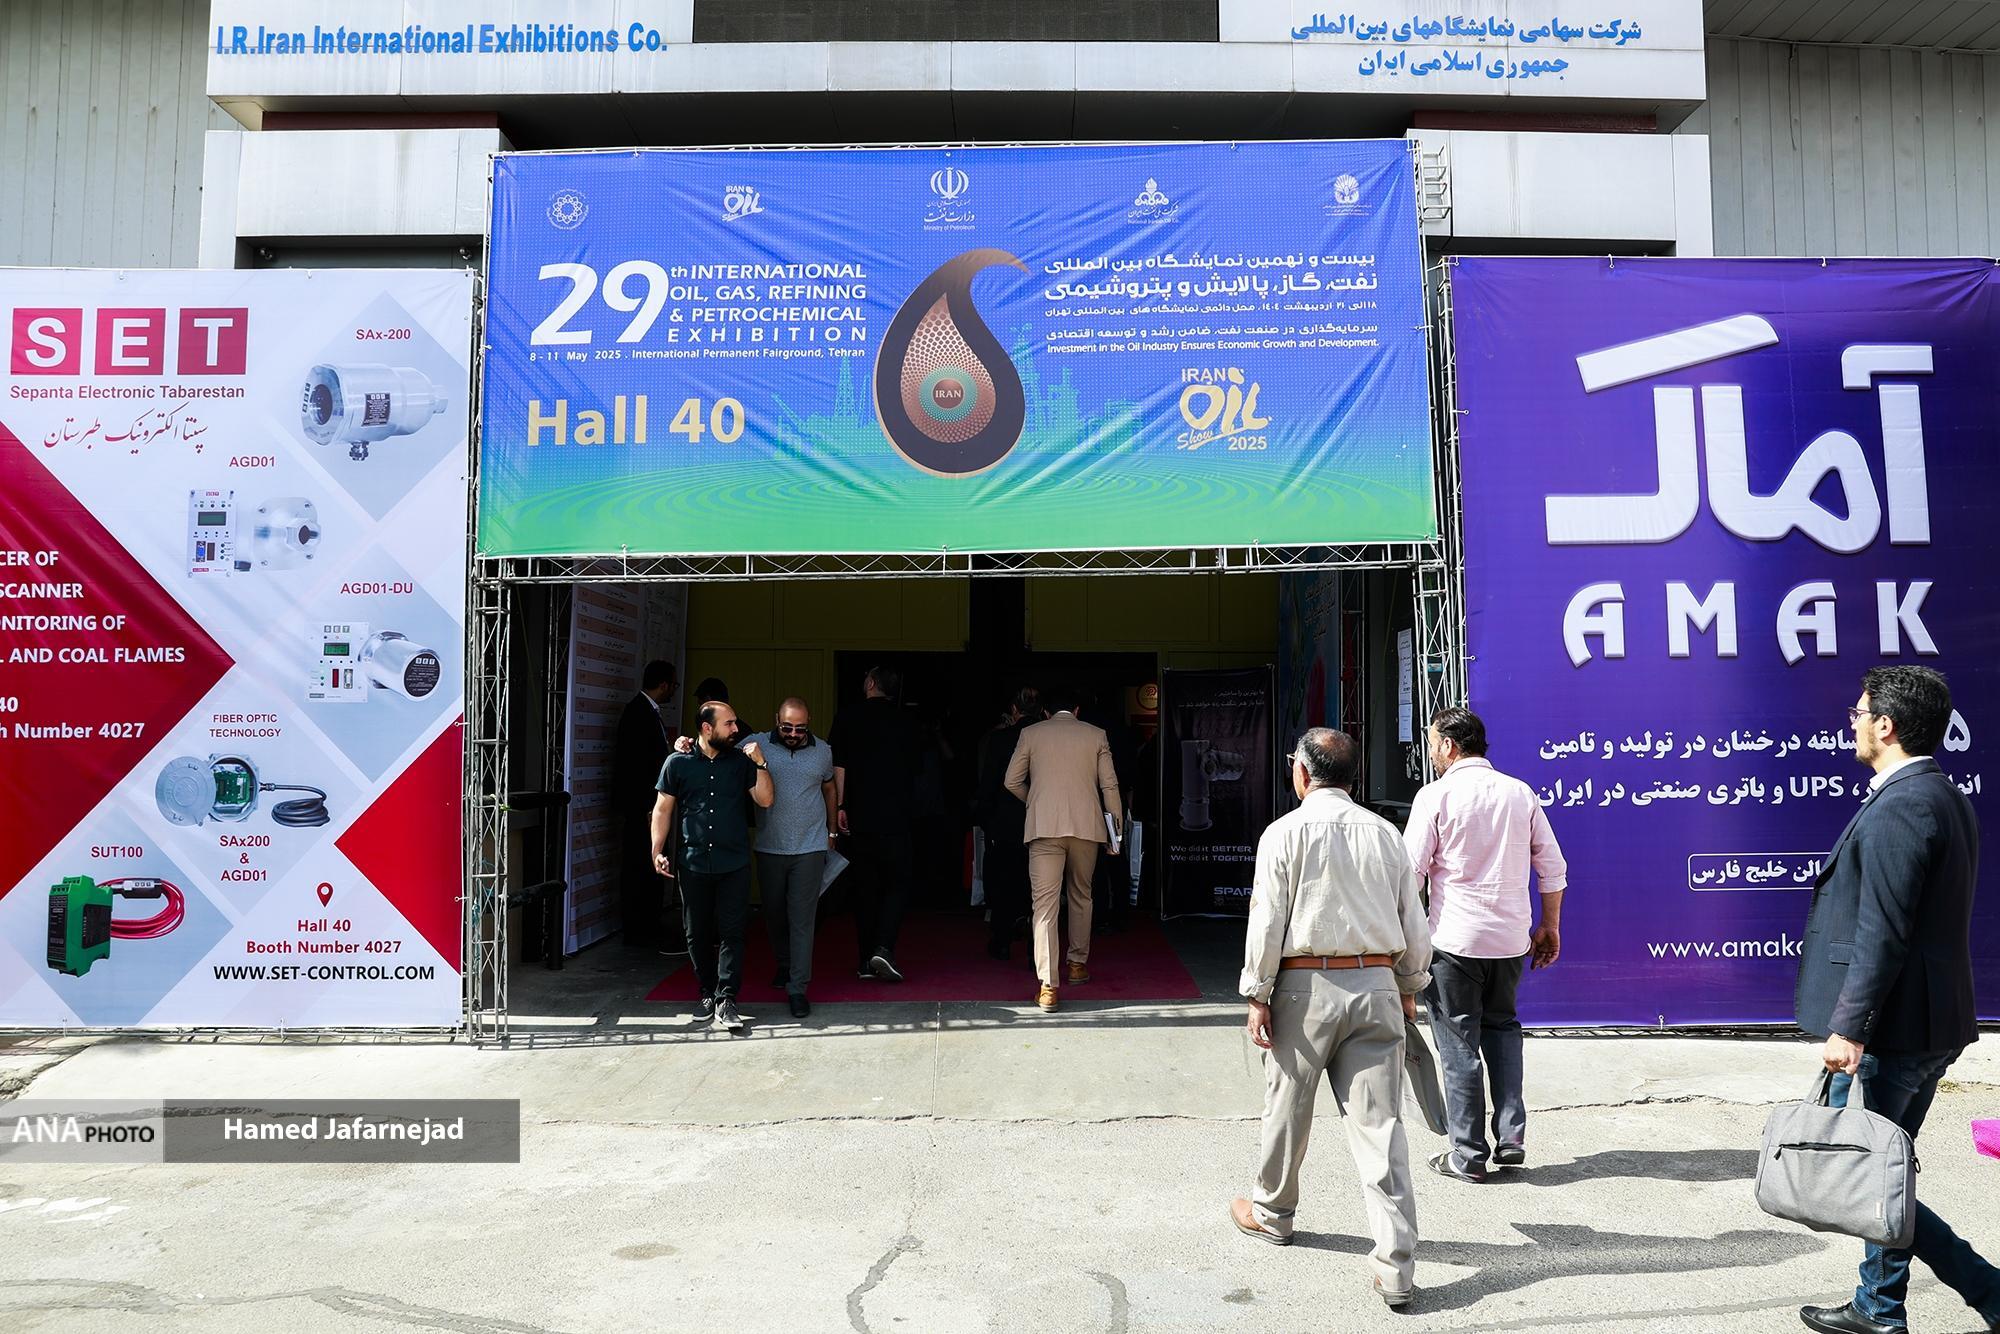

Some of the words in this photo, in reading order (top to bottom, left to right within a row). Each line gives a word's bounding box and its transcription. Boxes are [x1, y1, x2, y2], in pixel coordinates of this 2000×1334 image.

[217, 25, 304, 54] I.R.Iran
[313, 24, 472, 54] International
[479, 23, 618, 53] Exhibitions
[627, 22, 668, 51] Co.
[1519, 17, 1583, 43] سهامی
[1589, 19, 1641, 45] شرکت
[1359, 50, 1405, 77] ایران
[1410, 50, 1481, 76] اسلامی
[1485, 55, 1569, 81] جمهوری
[1145, 252, 1243, 270] نمایشگاه
[1247, 253, 1303, 268] نهمین
[1308, 256, 1318, 267] و
[1322, 254, 1375, 266] بیست
[692, 263, 866, 279] INTERNATIONAL
[670, 286, 708, 302] OIL,
[715, 286, 761, 302] GAS,
[768, 284, 866, 300] REFINING
[1045, 275, 1172, 300] پتروشیمی
[1177, 281, 1190, 296] و
[1194, 272, 1268, 299] پالایش
[530, 260, 669, 346] 29
[1152, 304, 1199, 314] نمایشگاه
[1232, 304, 1255, 313] محل
[1284, 301, 1332, 311] اردیبهشت
[670, 308, 684, 322] &
[692, 307, 866, 322] PETROCHEMICAL
[1045, 307, 1070, 317] تهران
[355, 328, 411, 341] SAx-200
[668, 327, 866, 343] EXHIBITION
[1046, 328, 1094, 340] اقتصادی
[1097, 327, 1136, 338] توسعه
[1139, 329, 1147, 338] و
[1151, 325, 1175, 337] رشد
[1178, 325, 1211, 336] ضامن
[1244, 325, 1279, 335] صنعت
[1283, 326, 1295, 335] در
[24, 317, 233, 367] SET
[1047, 343, 1097, 353] Investment
[1099, 343, 1108, 352] in
[1110, 342, 1125, 352] the
[1127, 341, 1140, 351] Oil
[1142, 341, 1179, 353] Industry
[1181, 341, 1216, 350] Ensures
[1218, 339, 1261, 349] Economic
[1263, 338, 1296, 348] Growth
[1298, 338, 1316, 348] and
[1319, 337, 1379, 349] Development.
[567, 352, 587, 362] May
[595, 351, 621, 360] 2025
[632, 349, 699, 359] International
[703, 348, 759, 358] Permanent
[763, 348, 824, 359] Fairground,
[829, 347, 865, 357] Tehran
[1181, 368, 1225, 382] IRAN
[10, 384, 74, 402] Sepanta
[78, 384, 155, 399] Electronic
[160, 384, 245, 399] Tabarestan
[935, 390, 962, 398] IRAN
[527, 394, 647, 447] Hall
[669, 397, 746, 446] 40
[1177, 429, 1214, 449] Show
[1228, 436, 1267, 451] 2025
[1545, 314, 1934, 554] آماک
[229, 456, 276, 468] AGD01
[35, 551, 59, 566] OF
[340, 583, 413, 595] AGD01-DU
[0, 615, 97, 631] NITORING
[102, 615, 126, 630] OF
[1563, 581, 1940, 668] AMAK
[9, 648, 53, 663] AND
[58, 648, 109, 663] COAL
[115, 647, 185, 663] FLAMES
[213, 713, 243, 724] FIBER
[246, 713, 278, 724] OPTIC
[15, 722, 93, 738] Number
[99, 723, 145, 738] 4027
[209, 728, 281, 738] TECHNOLOGY
[1539, 731, 1596, 760] تامین
[1601, 739, 1614, 759] و
[1619, 730, 1673, 759] تولید
[1679, 734, 1706, 759] در
[1537, 778, 1592, 807] ایران
[1599, 782, 1625, 807] در
[1631, 780, 1701, 806] صنعتی
[1707, 776, 1765, 805] باتری
[1770, 783, 1784, 805] و
[1789, 775, 1844, 798] UPS
[219, 834, 270, 848] SAx200
[91, 846, 143, 858] SUT100
[239, 853, 249, 864] &
[220, 869, 267, 881] AGD01
[1692, 859, 1741, 884] فارس
[1745, 859, 1787, 883] خلیج
[1793, 859, 1821, 882] الن
[297, 918, 329, 932] Hall
[333, 918, 351, 932] 40
[246, 940, 292, 954] Booth
[297, 940, 359, 954] Number
[364, 940, 402, 954] 4027
[213, 965, 435, 982] WWW.SET-CONTROL.COM
